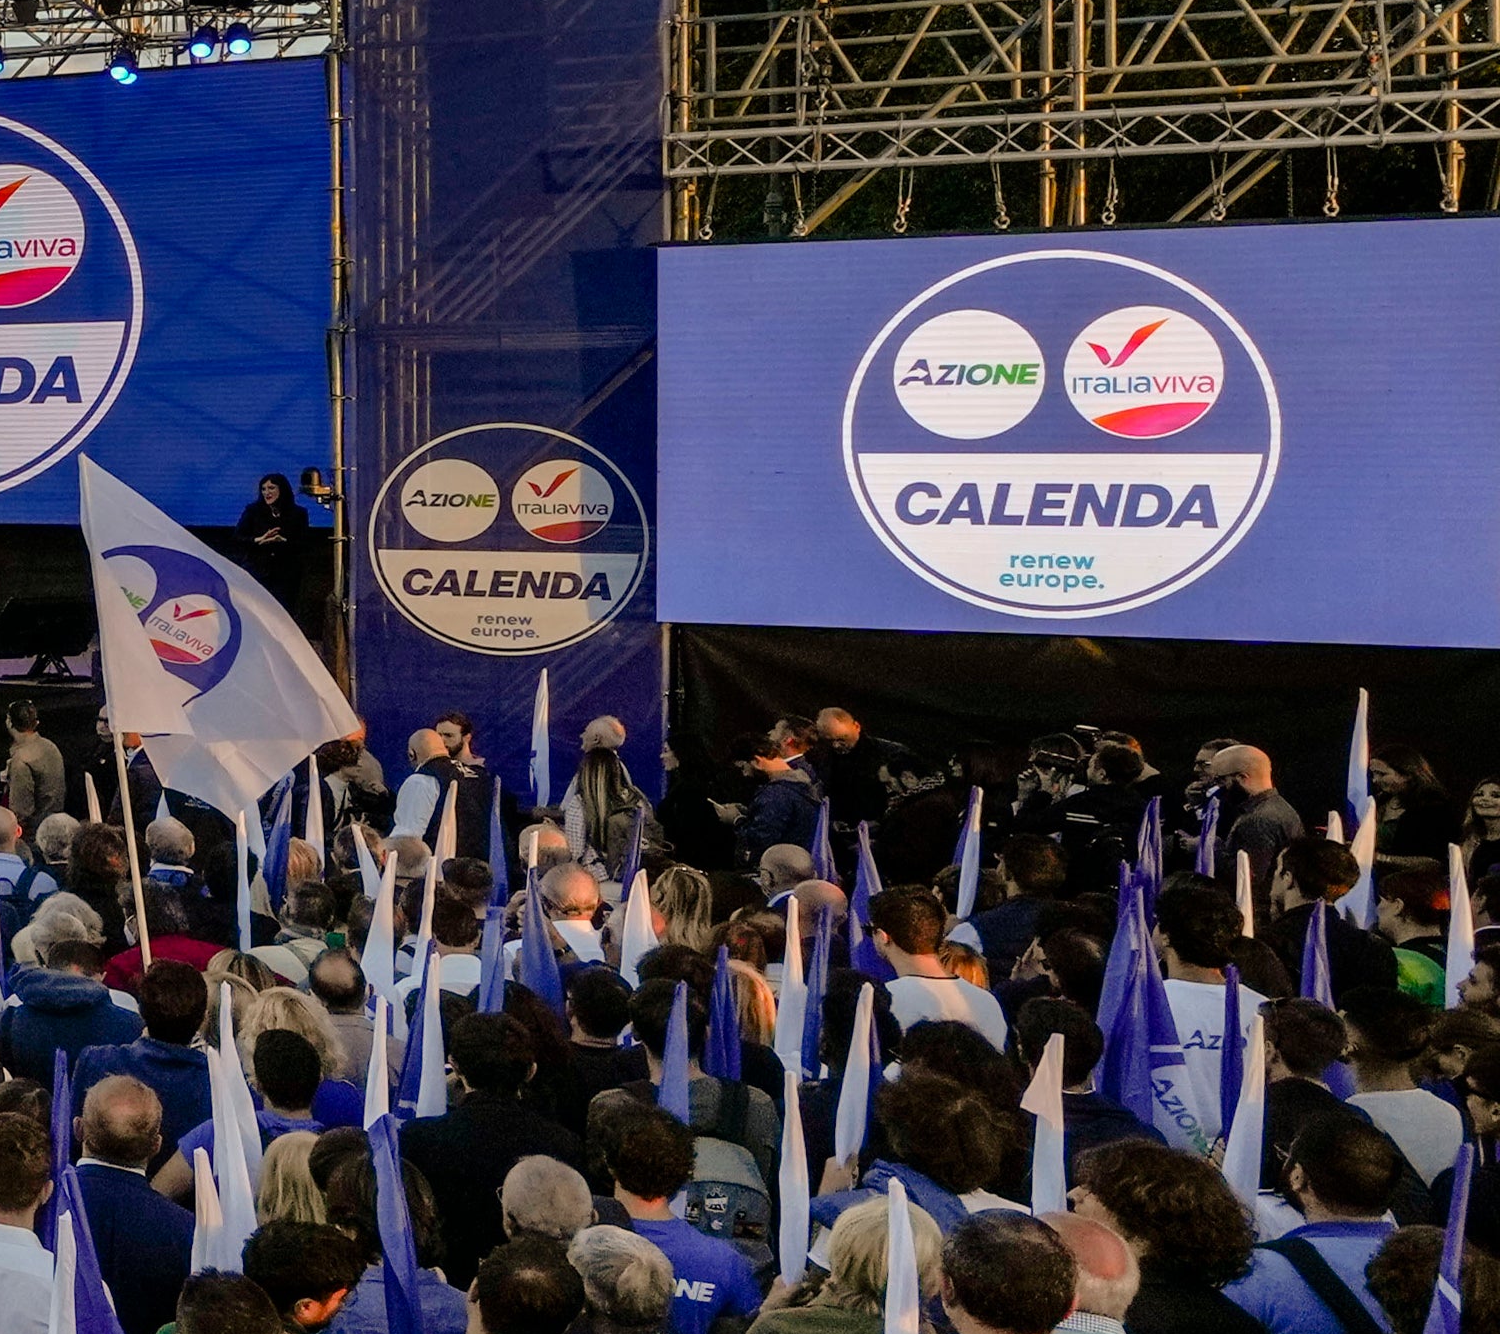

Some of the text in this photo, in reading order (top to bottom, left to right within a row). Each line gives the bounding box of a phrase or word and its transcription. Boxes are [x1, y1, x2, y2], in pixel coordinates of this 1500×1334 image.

[898, 358, 1040, 386] AZIONE
[405, 489, 496, 508] AZIONE
[895, 481, 1219, 529] CALENDA
[1010, 552, 1095, 569] renew
[402, 568, 612, 601] CALENDA
[999, 572, 1105, 593] europe.
[477, 614, 532, 626] renew
[471, 627, 540, 640] europe.
